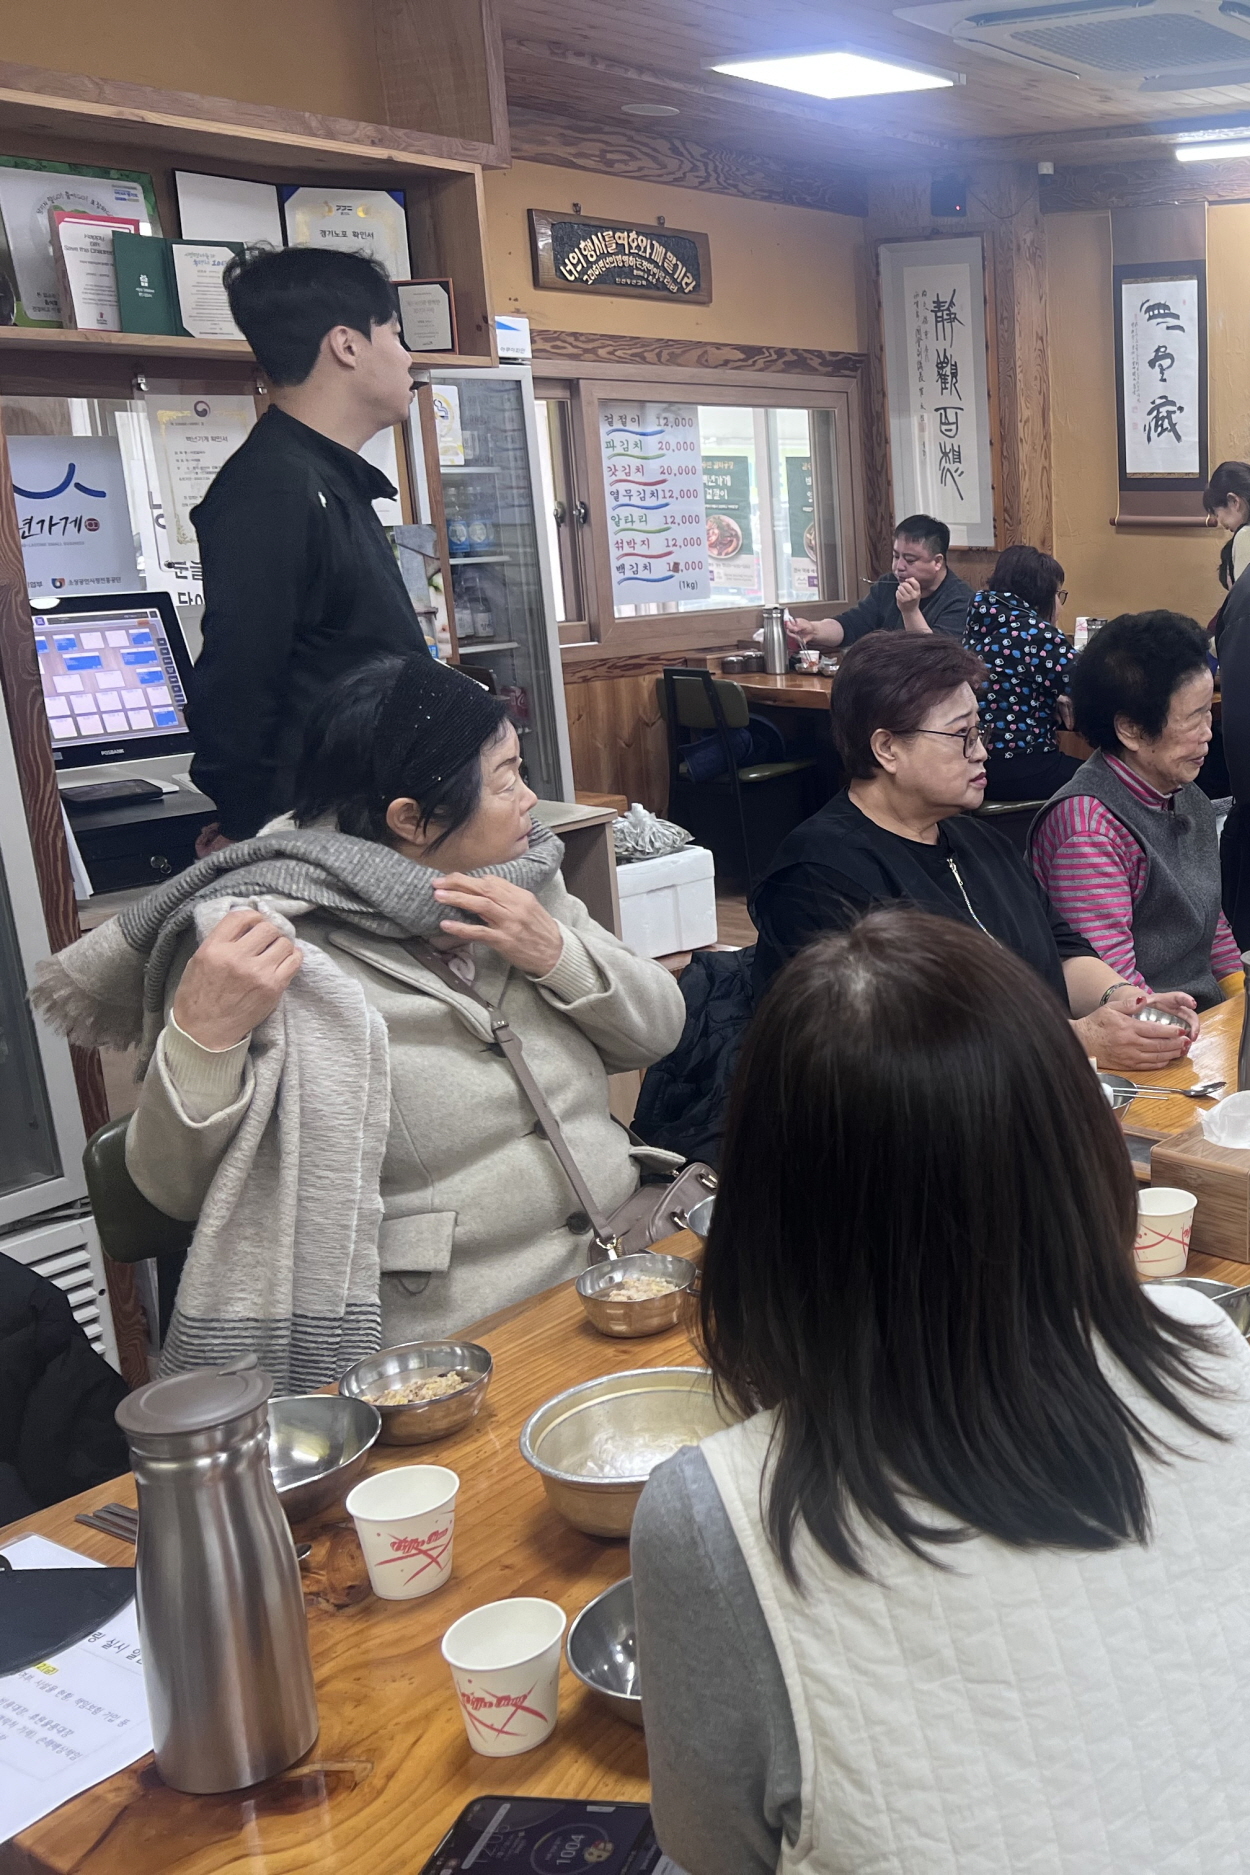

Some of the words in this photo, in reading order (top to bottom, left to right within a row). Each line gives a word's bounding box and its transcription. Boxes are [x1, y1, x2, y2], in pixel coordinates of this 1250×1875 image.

[319, 229, 348, 239] 경기노포
[352, 230, 374, 240] 확인서
[560, 247, 587, 282] 너의
[579, 230, 618, 262] 행사를
[615, 230, 665, 266] 여호와께
[664, 251, 697, 294] 맡기라
[604, 414, 641, 428] 겉절이
[656, 416, 694, 428] 12,000
[605, 439, 643, 452] 파김치
[658, 441, 695, 453] 20,000
[607, 464, 645, 477] 갓김치
[659, 465, 697, 477] 20,000
[610, 489, 659, 502] 열무김치
[661, 489, 698, 501] 12,000
[705, 488, 728, 500] 겉절이
[611, 514, 648, 527] 알타리
[663, 514, 700, 526] 12,000
[18, 515, 82, 540] 년가게
[614, 538, 650, 551] 섞박지
[665, 537, 702, 549] 12,000
[616, 562, 652, 575] 백김치
[667, 561, 703, 573] 1,000
[68, 576, 122, 586] 소상공인시장진흥공단
[679, 580, 698, 590] (1kg)
[101, 1638, 129, 1654] 실시
